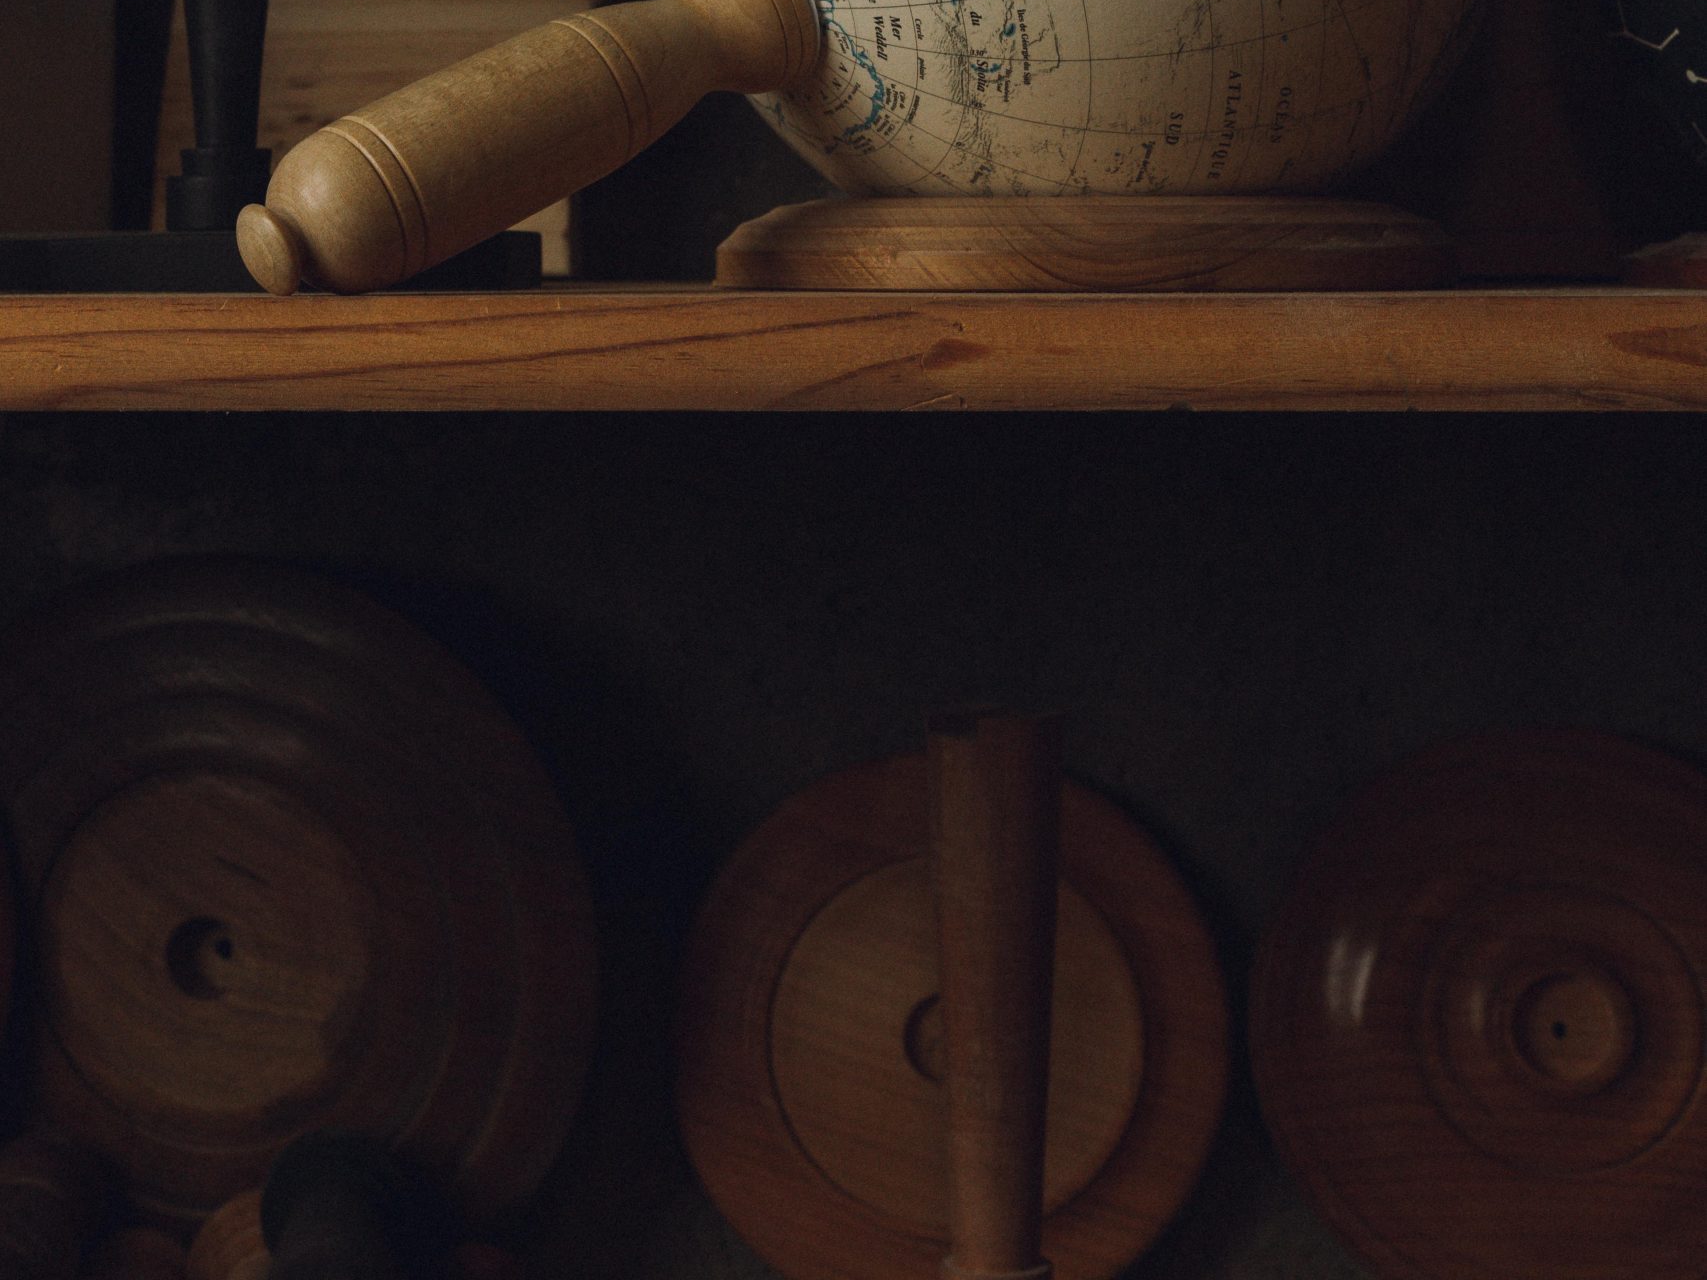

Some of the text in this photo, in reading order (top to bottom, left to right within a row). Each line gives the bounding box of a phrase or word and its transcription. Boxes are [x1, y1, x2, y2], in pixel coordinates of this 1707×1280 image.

[872, 15, 889, 62] Weddell
[889, 15, 903, 41] Mer
[969, 10, 983, 27] du
[1164, 111, 1185, 146] SUD
[1207, 69, 1244, 180] ATLANTIQUE
[1270, 86, 1293, 144] OCÉAN
